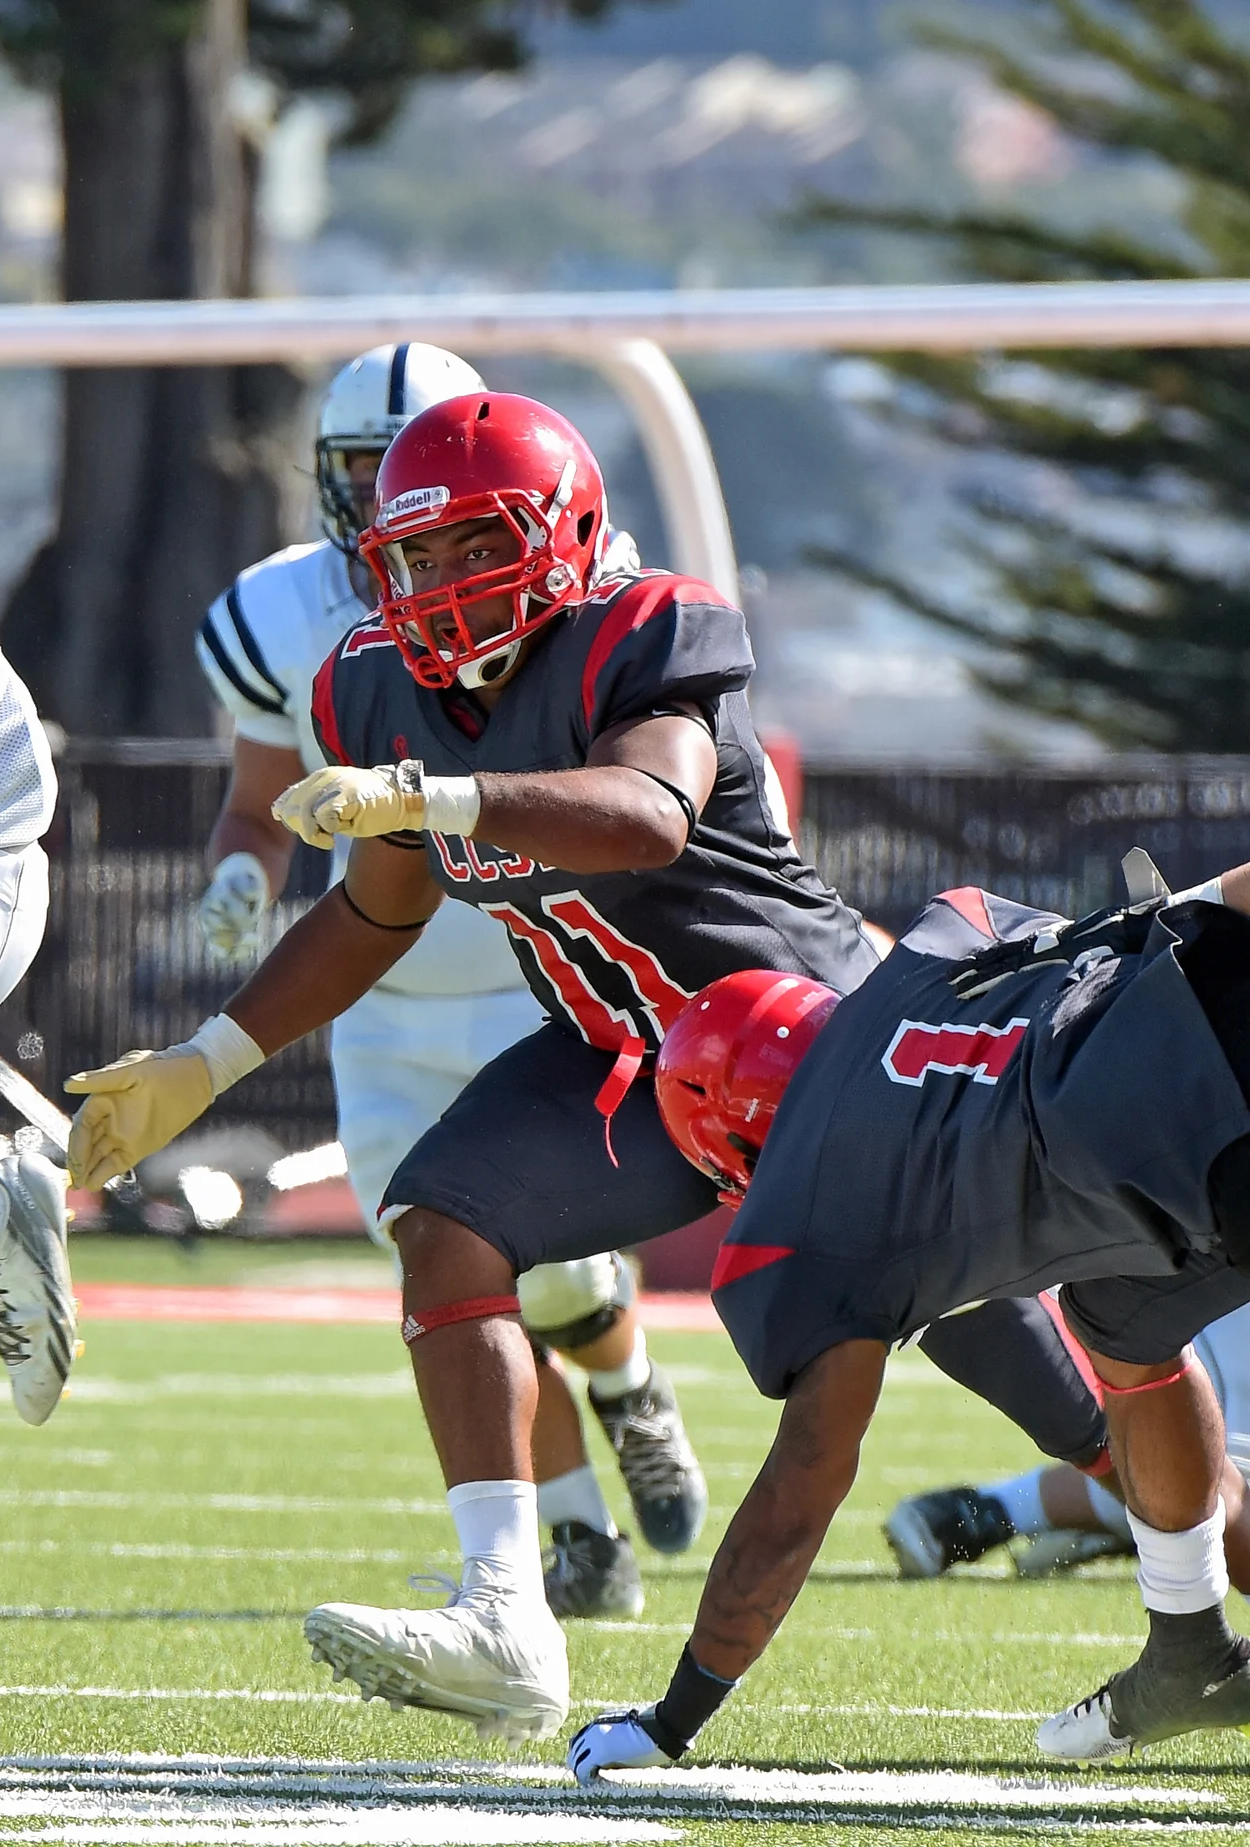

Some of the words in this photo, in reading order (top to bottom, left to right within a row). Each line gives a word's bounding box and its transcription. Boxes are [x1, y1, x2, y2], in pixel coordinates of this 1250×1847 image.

[395, 491, 431, 511] Riddell
[479, 890, 698, 1054] 11
[881, 1017, 1031, 1088] 1
